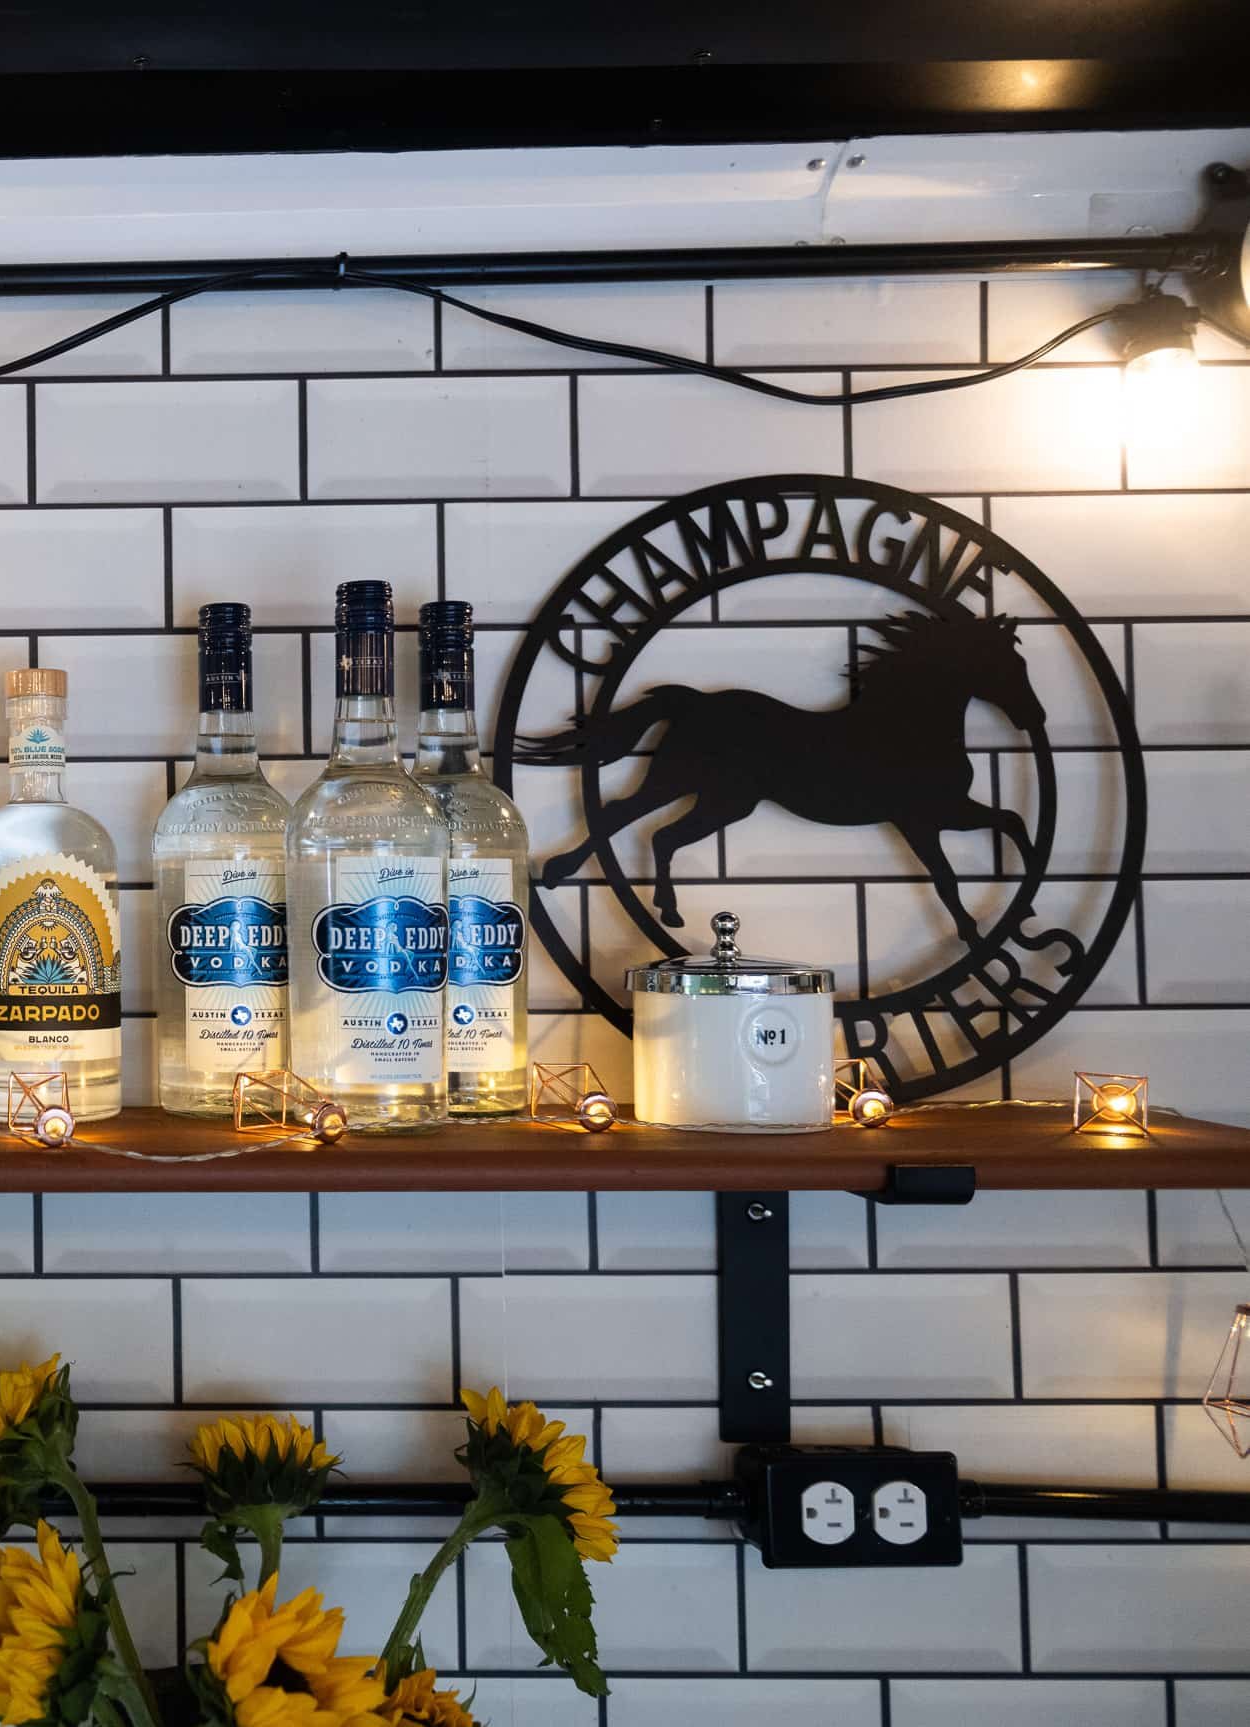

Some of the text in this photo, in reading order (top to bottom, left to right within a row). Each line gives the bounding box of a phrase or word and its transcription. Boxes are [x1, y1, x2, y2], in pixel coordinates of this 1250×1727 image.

[548, 494, 1012, 676] CHAMPAGNE
[379, 867, 404, 880] Dive
[180, 925, 287, 947] DEEP EDD
[329, 926, 447, 950] DEEP EDDY
[469, 924, 517, 946] EDDY
[190, 956, 287, 968] VODKA
[341, 960, 441, 973] VODKA
[455, 955, 511, 968] DKA
[18, 986, 79, 995] TEQUILA
[836, 903, 1088, 1092] RTERS
[192, 1011, 284, 1019] AUSTIN TEXAS
[342, 1018, 438, 1027] AUSTIN TEXAS
[28, 1035, 70, 1044] BLANCO
[199, 1028, 279, 1040] Distilled 10 Times
[463, 1029, 477, 1040] 10
[350, 1037, 434, 1050] Distilled 10 Times
